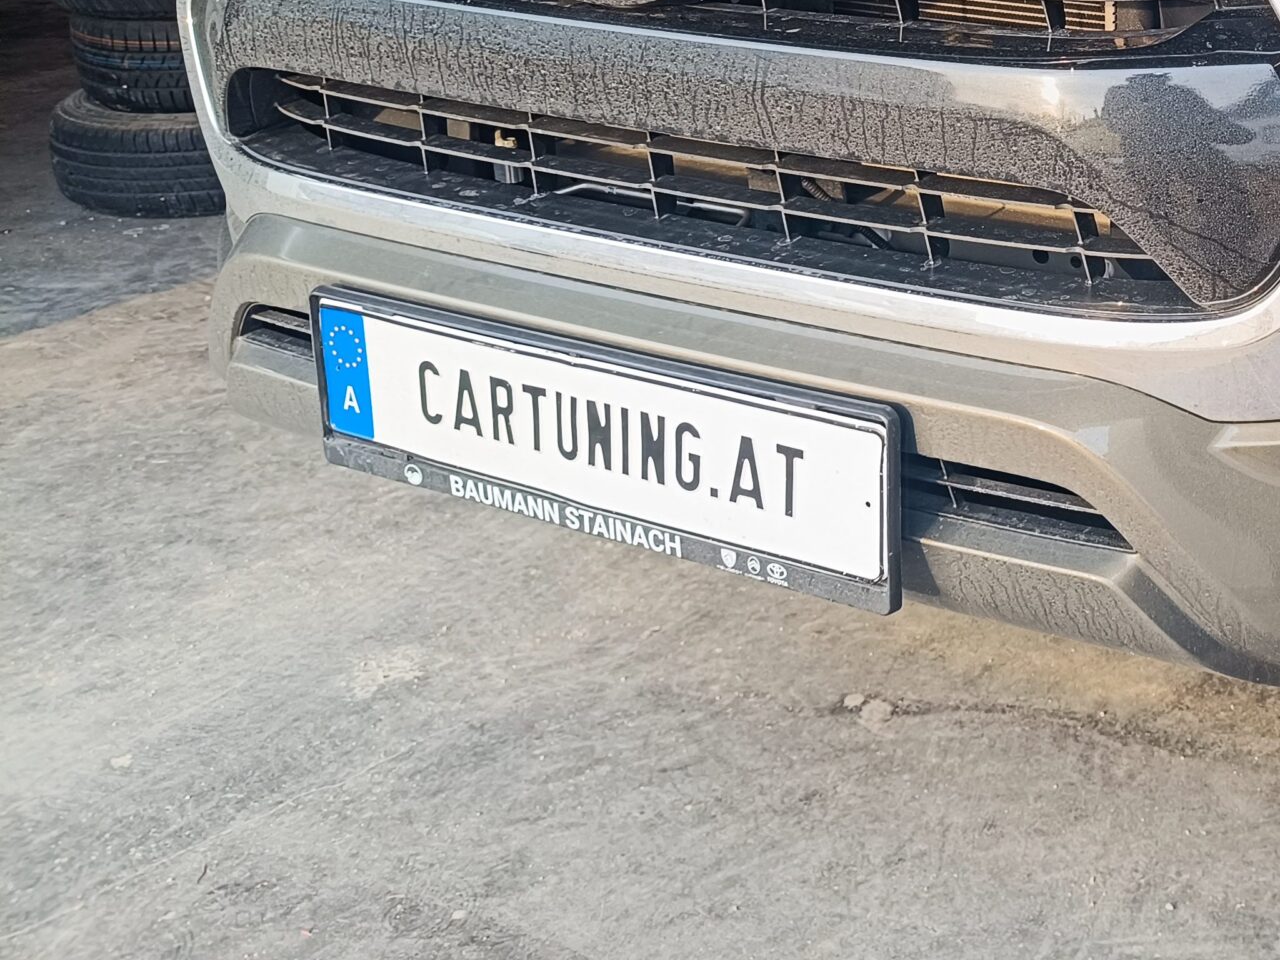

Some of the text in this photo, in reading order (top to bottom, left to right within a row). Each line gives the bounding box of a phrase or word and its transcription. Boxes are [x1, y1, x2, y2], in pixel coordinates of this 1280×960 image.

[343, 385, 360, 414] A
[418, 360, 804, 517] CARTUNING.AT
[449, 474, 683, 559] BAUMANN STAINACH
